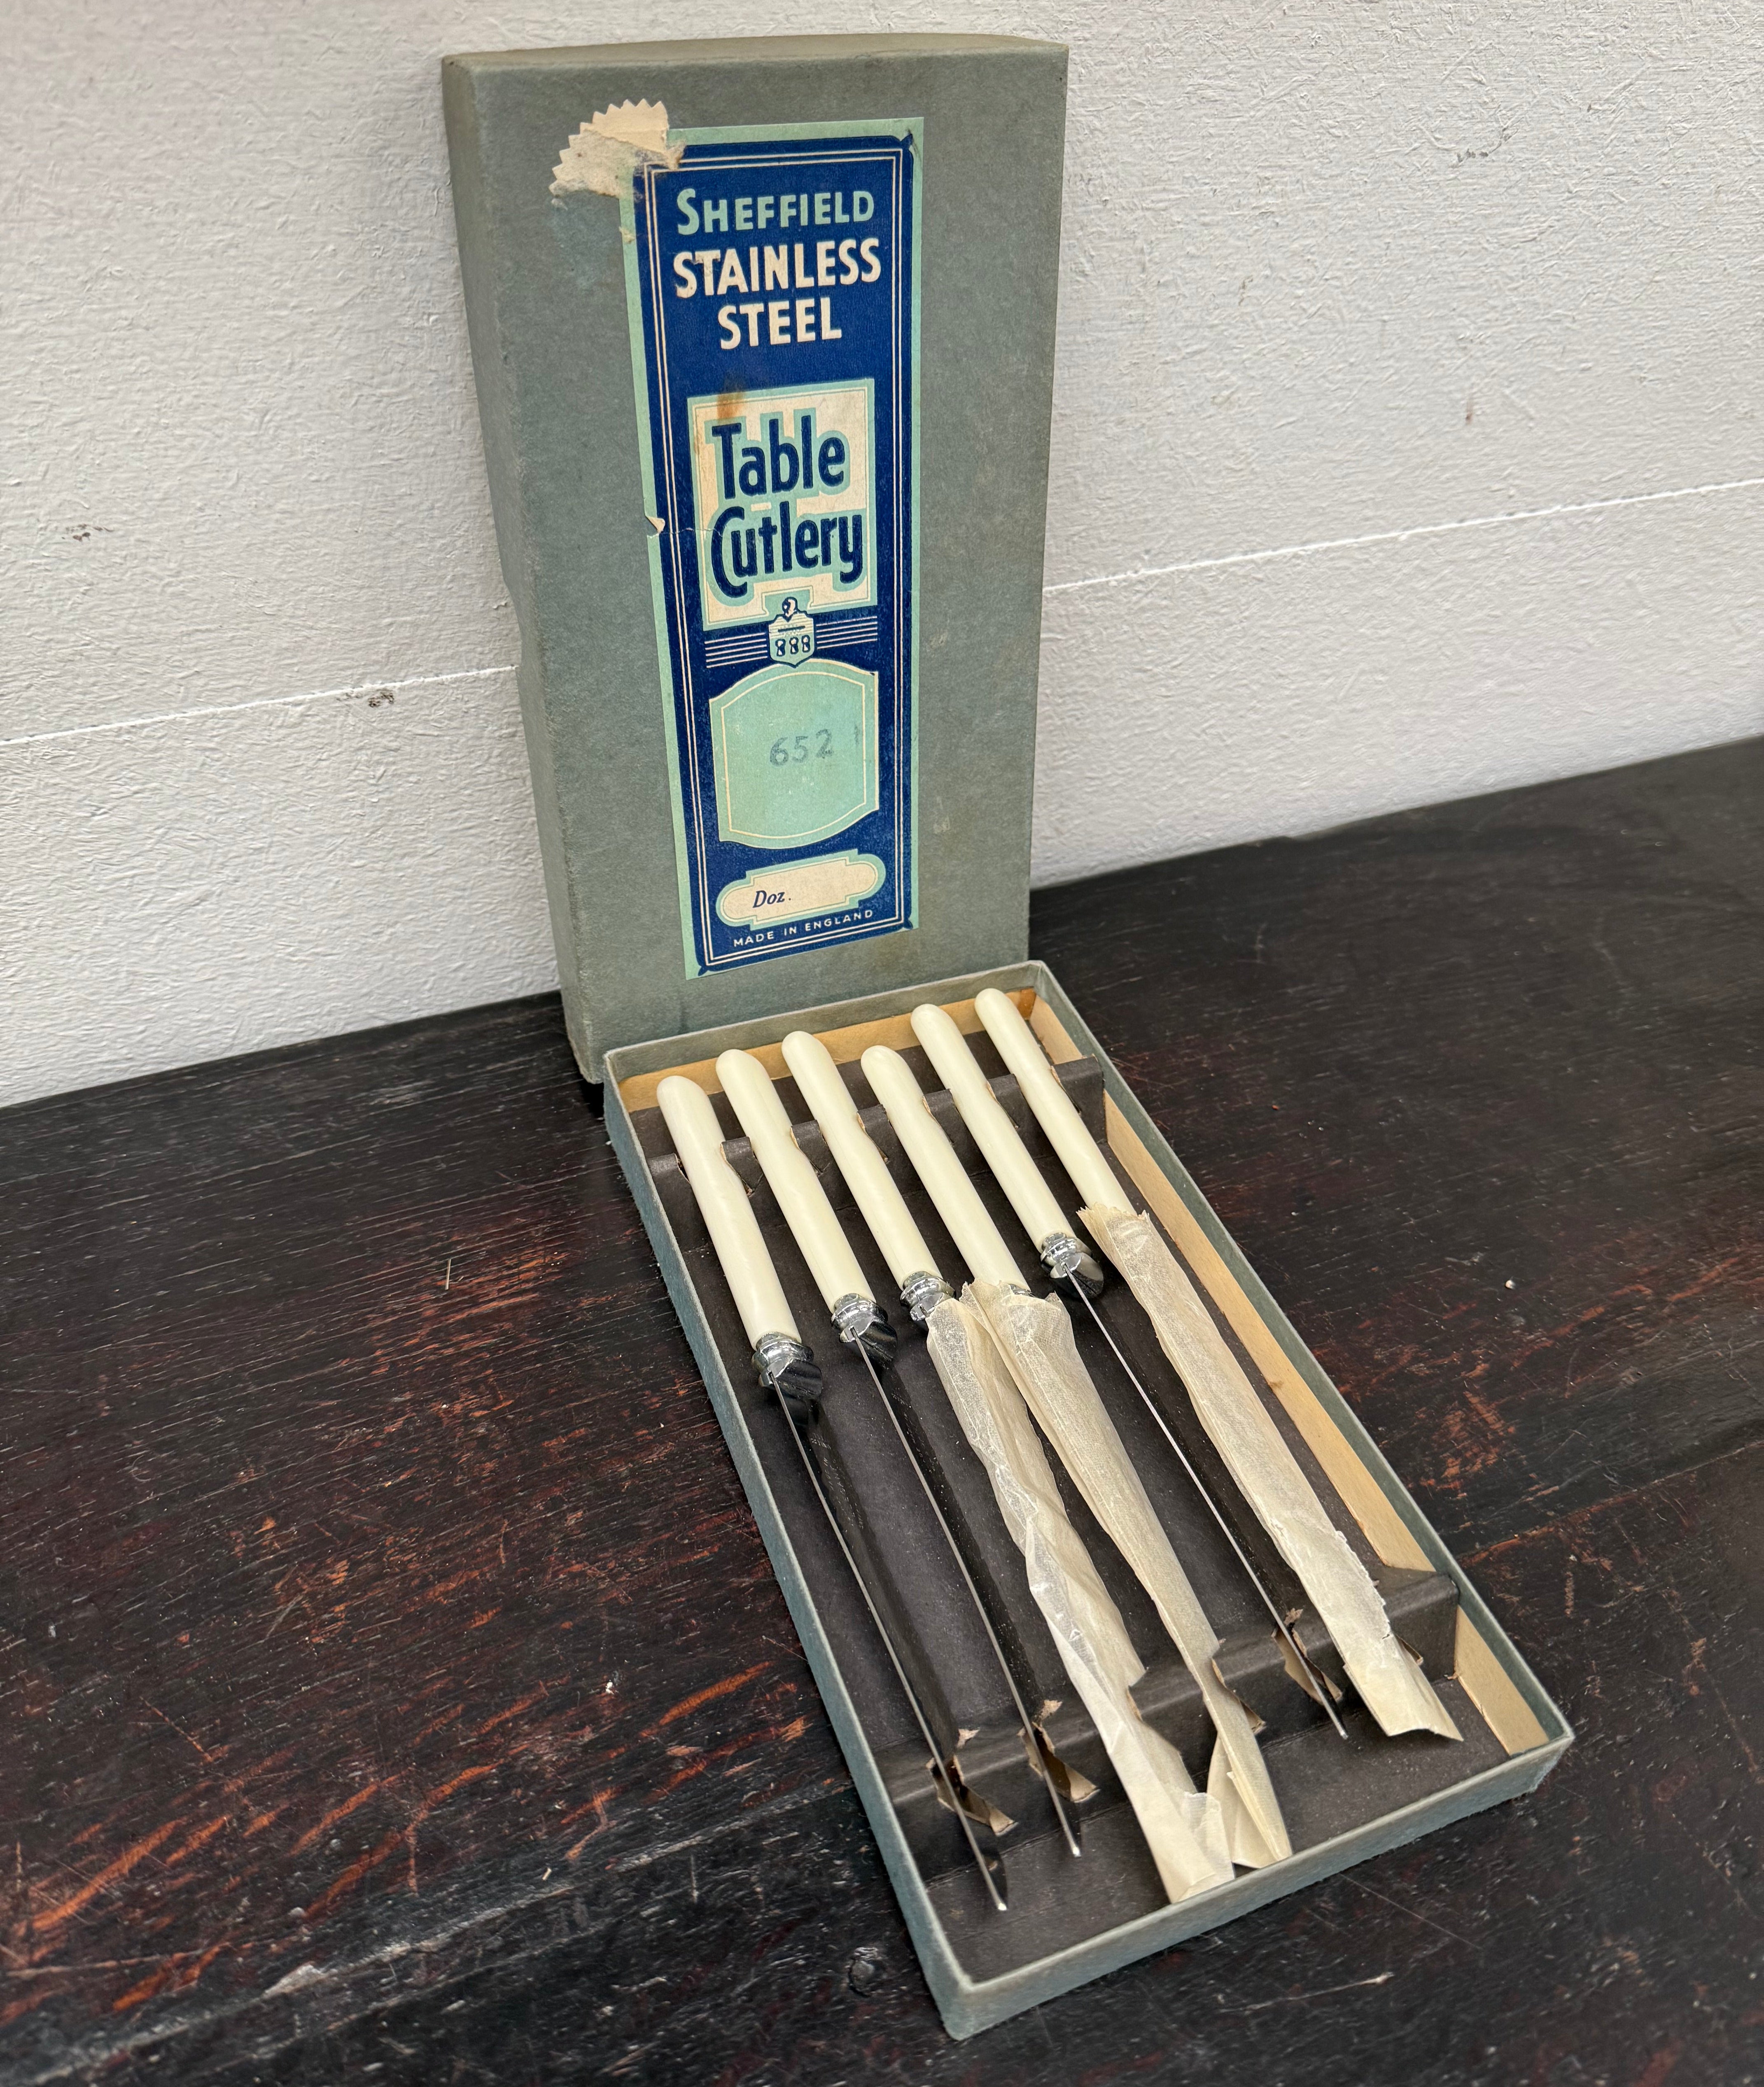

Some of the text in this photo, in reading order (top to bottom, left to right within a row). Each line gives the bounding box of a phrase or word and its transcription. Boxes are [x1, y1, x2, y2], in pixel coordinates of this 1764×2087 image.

[677, 188, 874, 235] SHEFFIELD
[673, 238, 881, 298] STAINLESS
[718, 297, 842, 350] STEEL
[712, 415, 845, 499] Table
[711, 501, 863, 598] Cutlery
[769, 729, 833, 767] 652
[752, 890, 791, 908] Doz.
[734, 909, 873, 947] MADE IN ENGLAND
